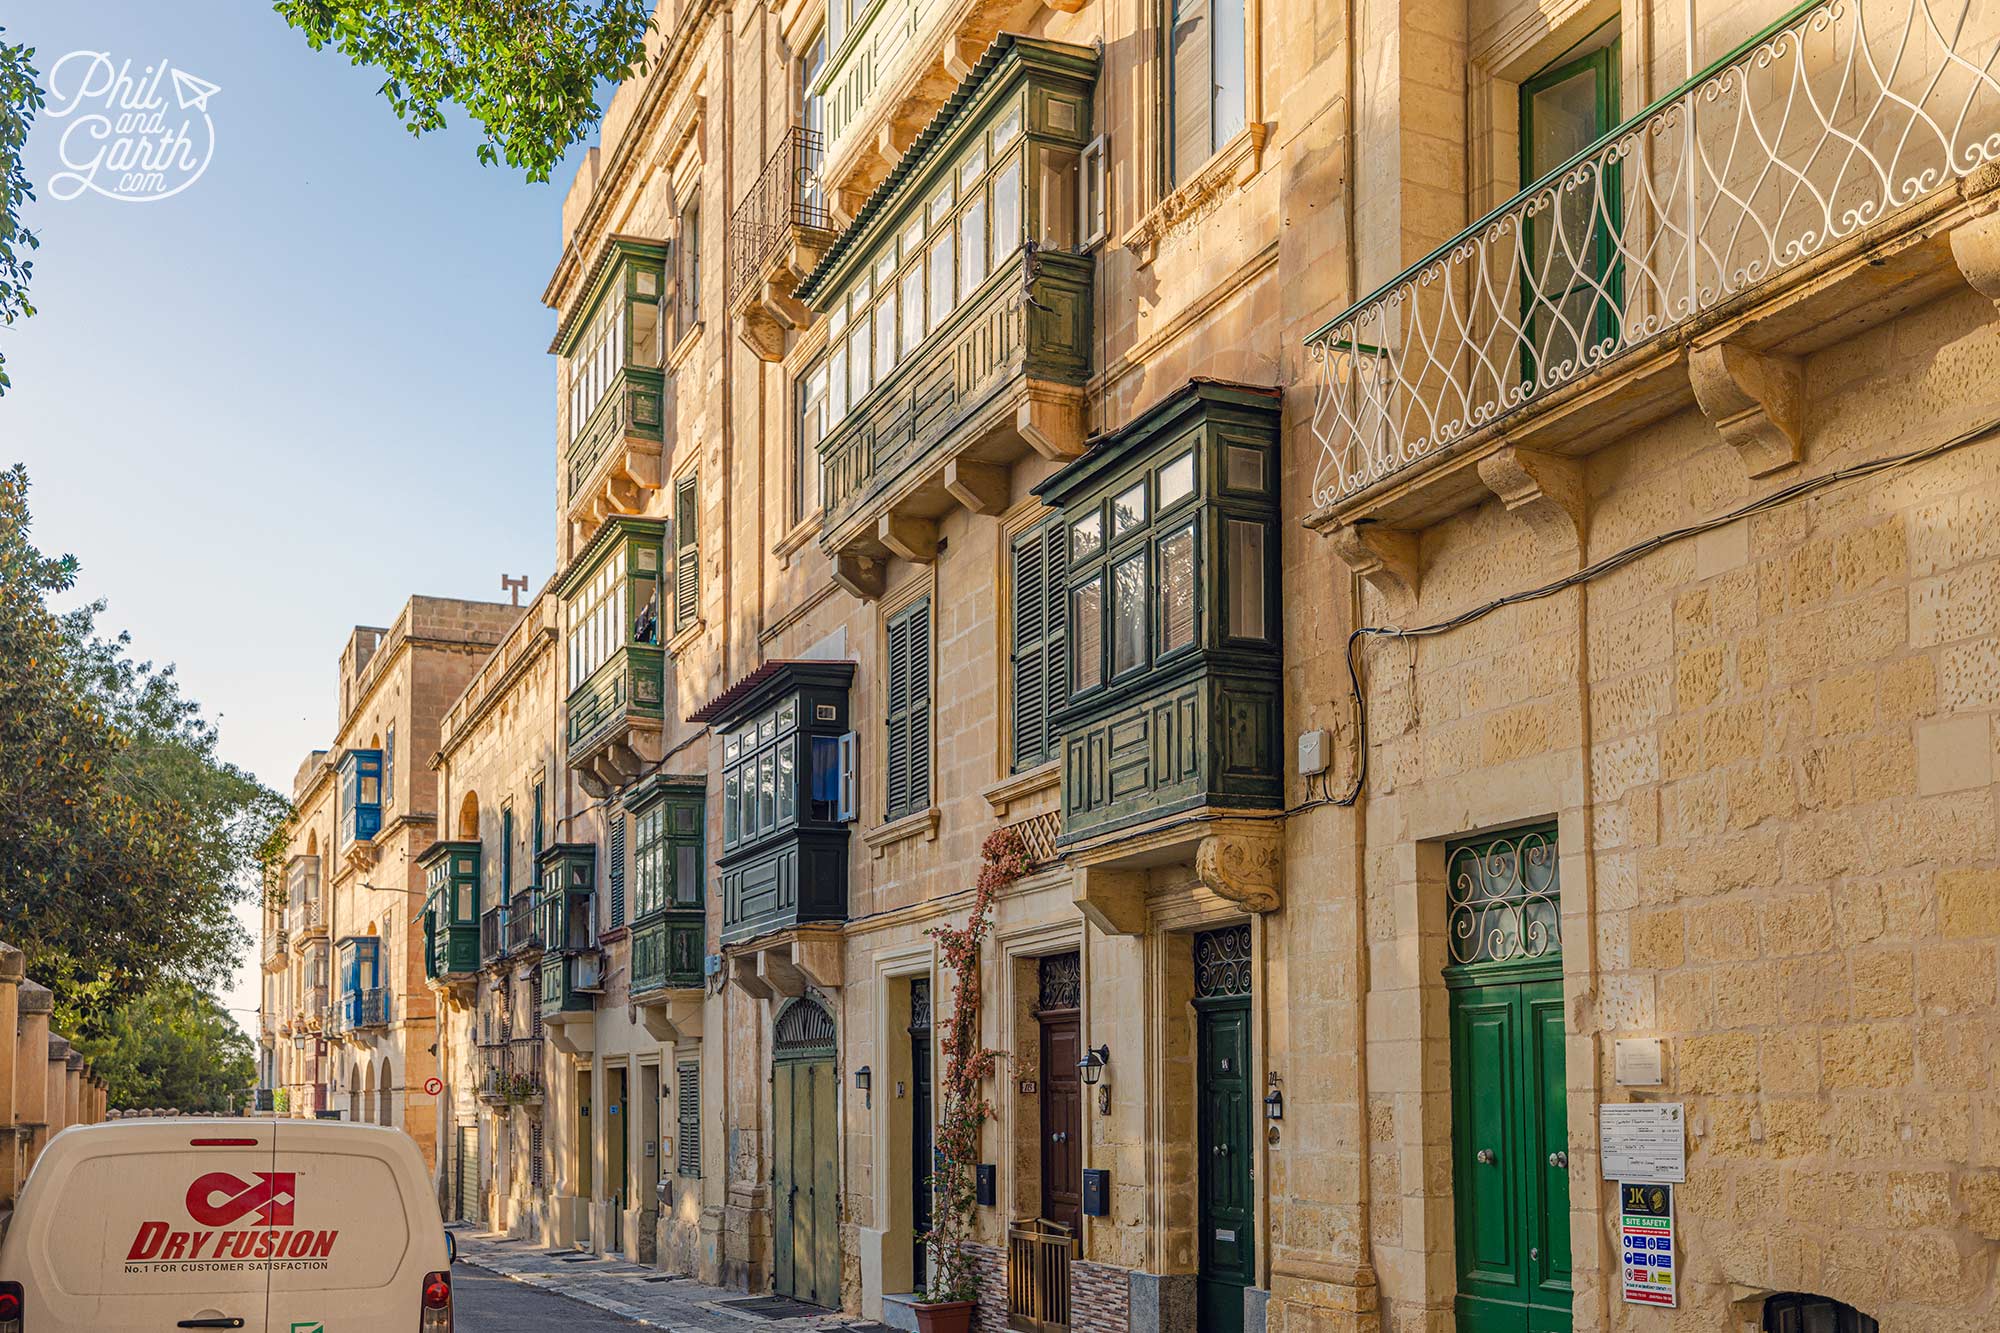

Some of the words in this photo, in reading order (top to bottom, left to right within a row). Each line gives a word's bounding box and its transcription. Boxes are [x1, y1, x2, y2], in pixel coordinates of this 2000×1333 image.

[1629, 1187, 1645, 1204] JK
[1625, 1217, 1641, 1226] SITE
[1641, 1218, 1667, 1228] SAFETY
[126, 1221, 214, 1260] DRY
[212, 1230, 339, 1259] FUSION
[124, 1264, 149, 1274] No.1
[153, 1264, 177, 1273] FOR
[181, 1263, 244, 1272] CUSTOMER
[248, 1261, 328, 1271] SATISFACTION
